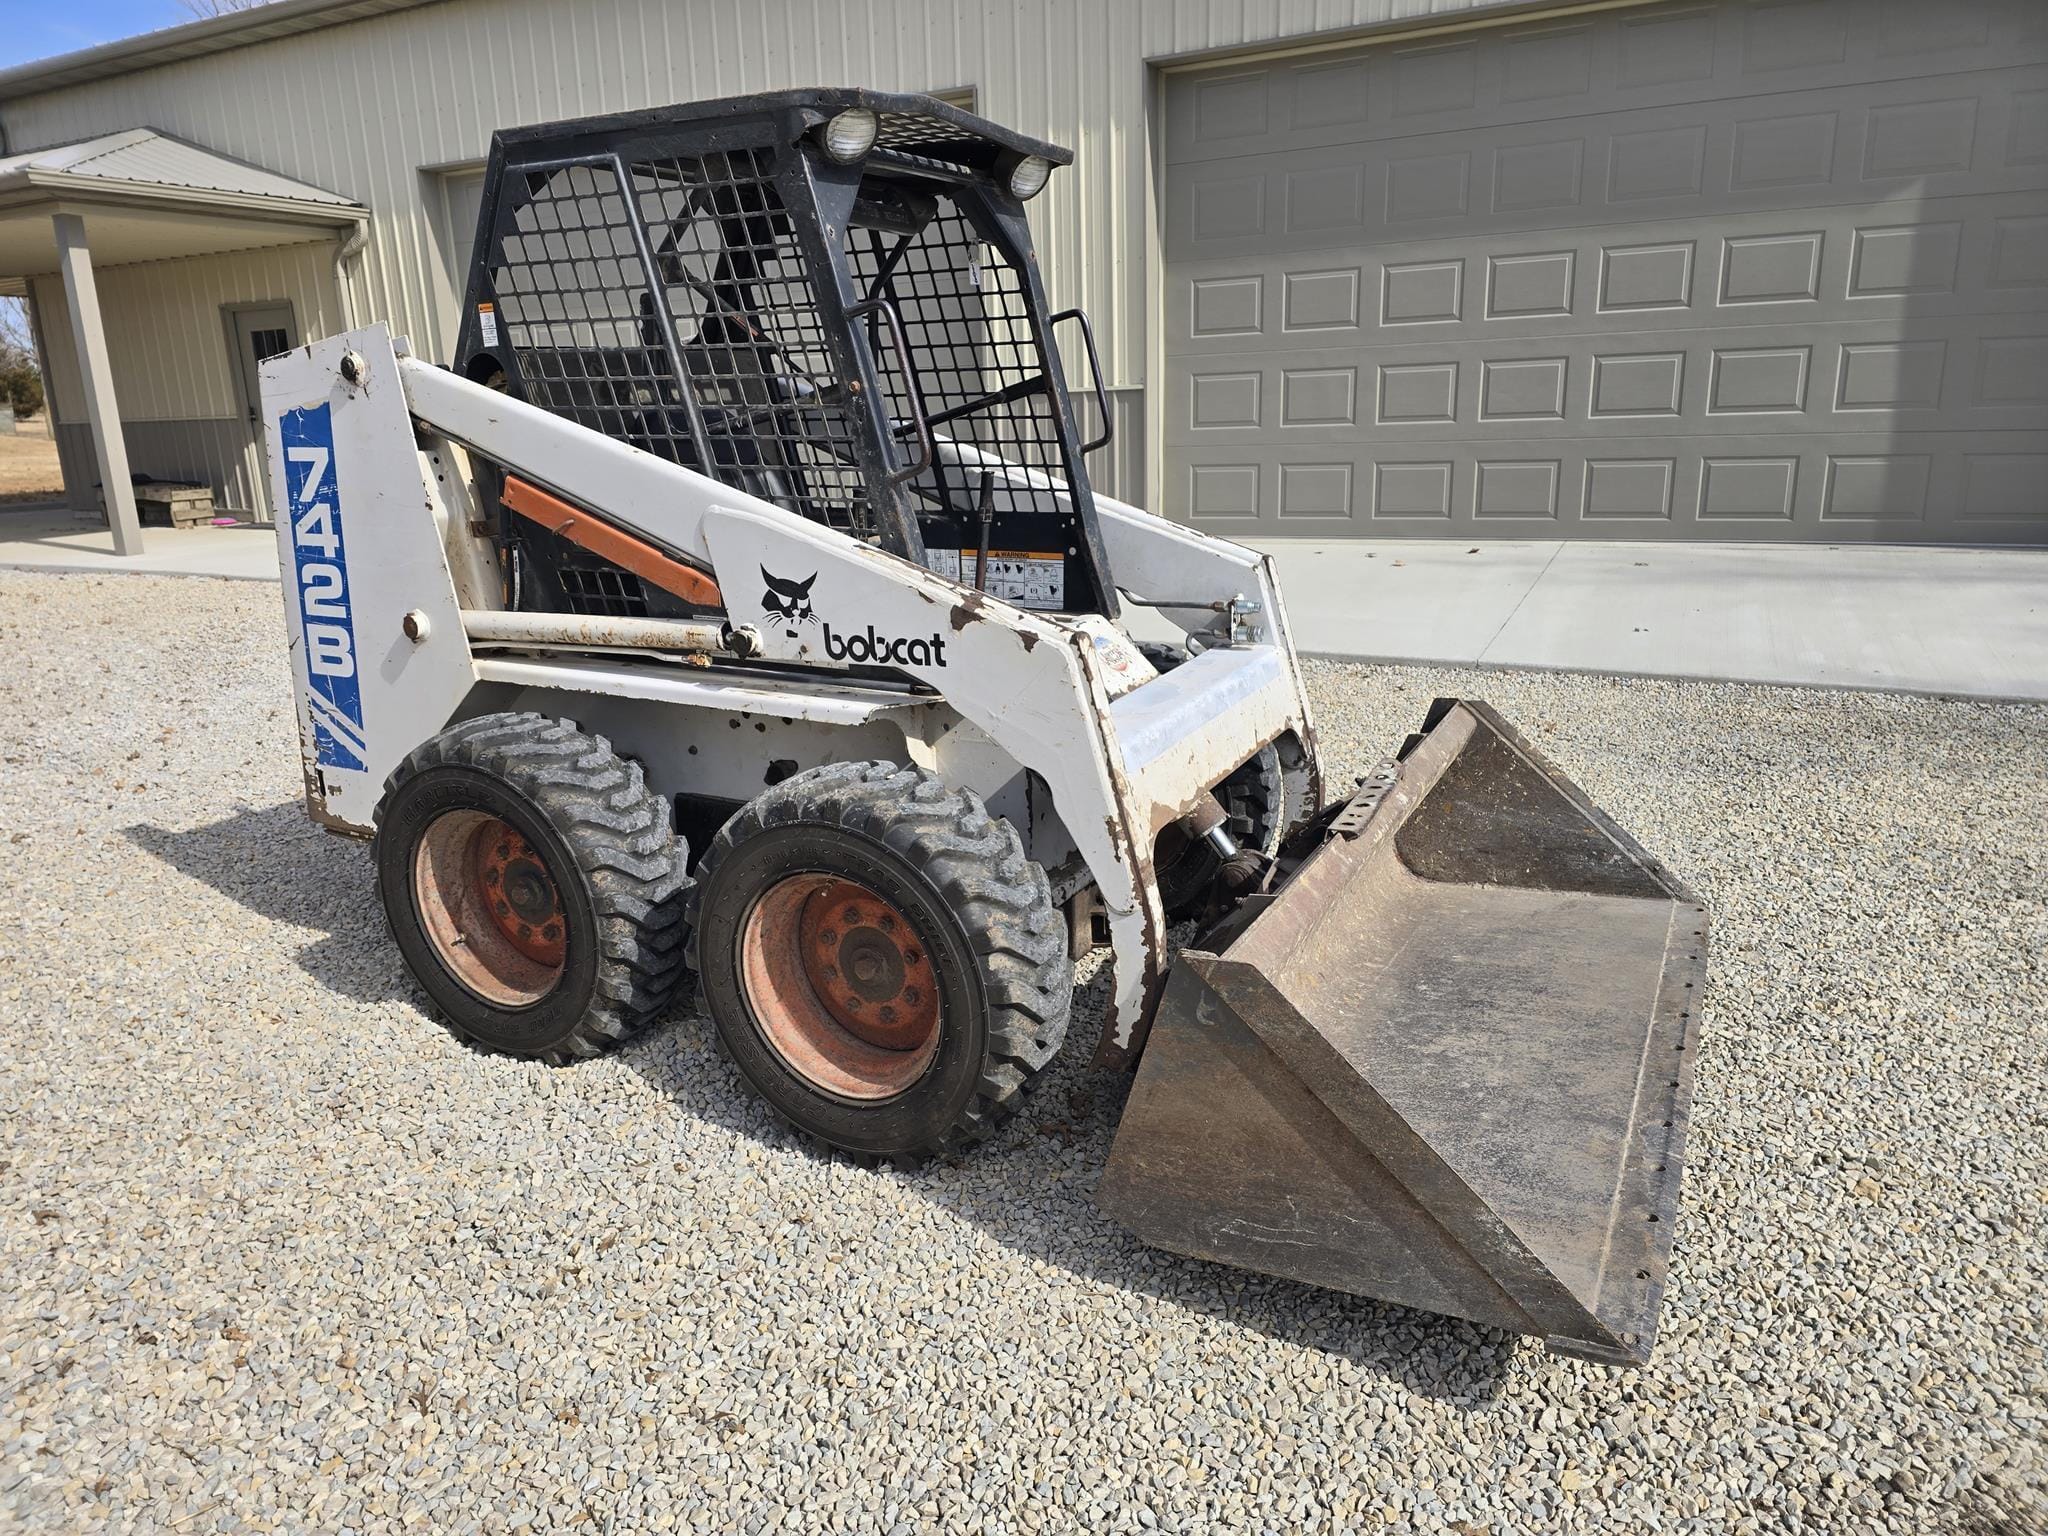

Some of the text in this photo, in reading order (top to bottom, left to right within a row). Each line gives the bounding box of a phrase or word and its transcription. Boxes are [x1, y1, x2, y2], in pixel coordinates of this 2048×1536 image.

[287, 446, 355, 679] 742B
[1001, 551, 1029, 559] WARNING
[822, 622, 947, 668] bobcat
